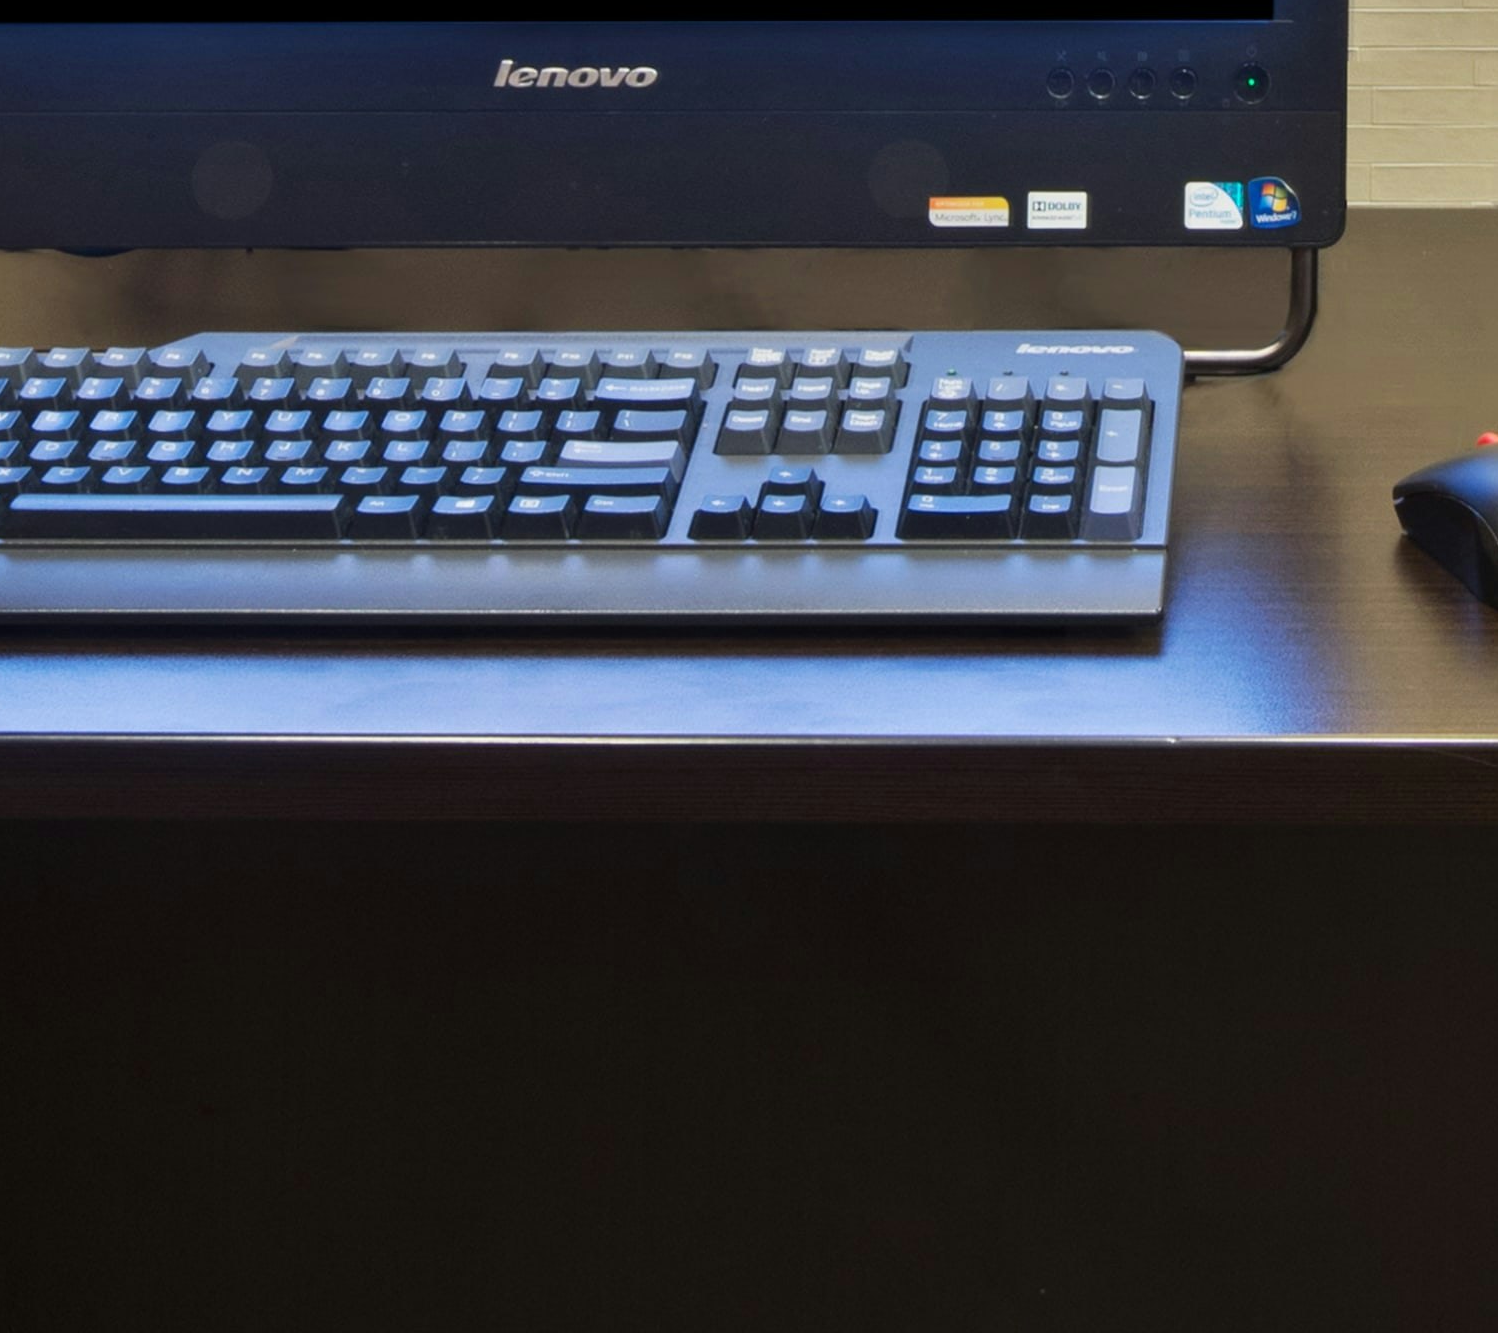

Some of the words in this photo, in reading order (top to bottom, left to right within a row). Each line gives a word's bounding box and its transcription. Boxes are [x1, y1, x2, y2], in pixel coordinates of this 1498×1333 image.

[493, 59, 658, 88] lenovo
[1047, 201, 1081, 211] DOLBY
[1189, 209, 1232, 219] Pentium
[1015, 343, 1135, 355] lenovo
[44, 412, 61, 423] E
[104, 412, 120, 423] R
[164, 412, 177, 423] T
[222, 412, 235, 423] Y
[277, 412, 293, 423] U
[394, 412, 411, 423] O
[451, 412, 467, 423] P
